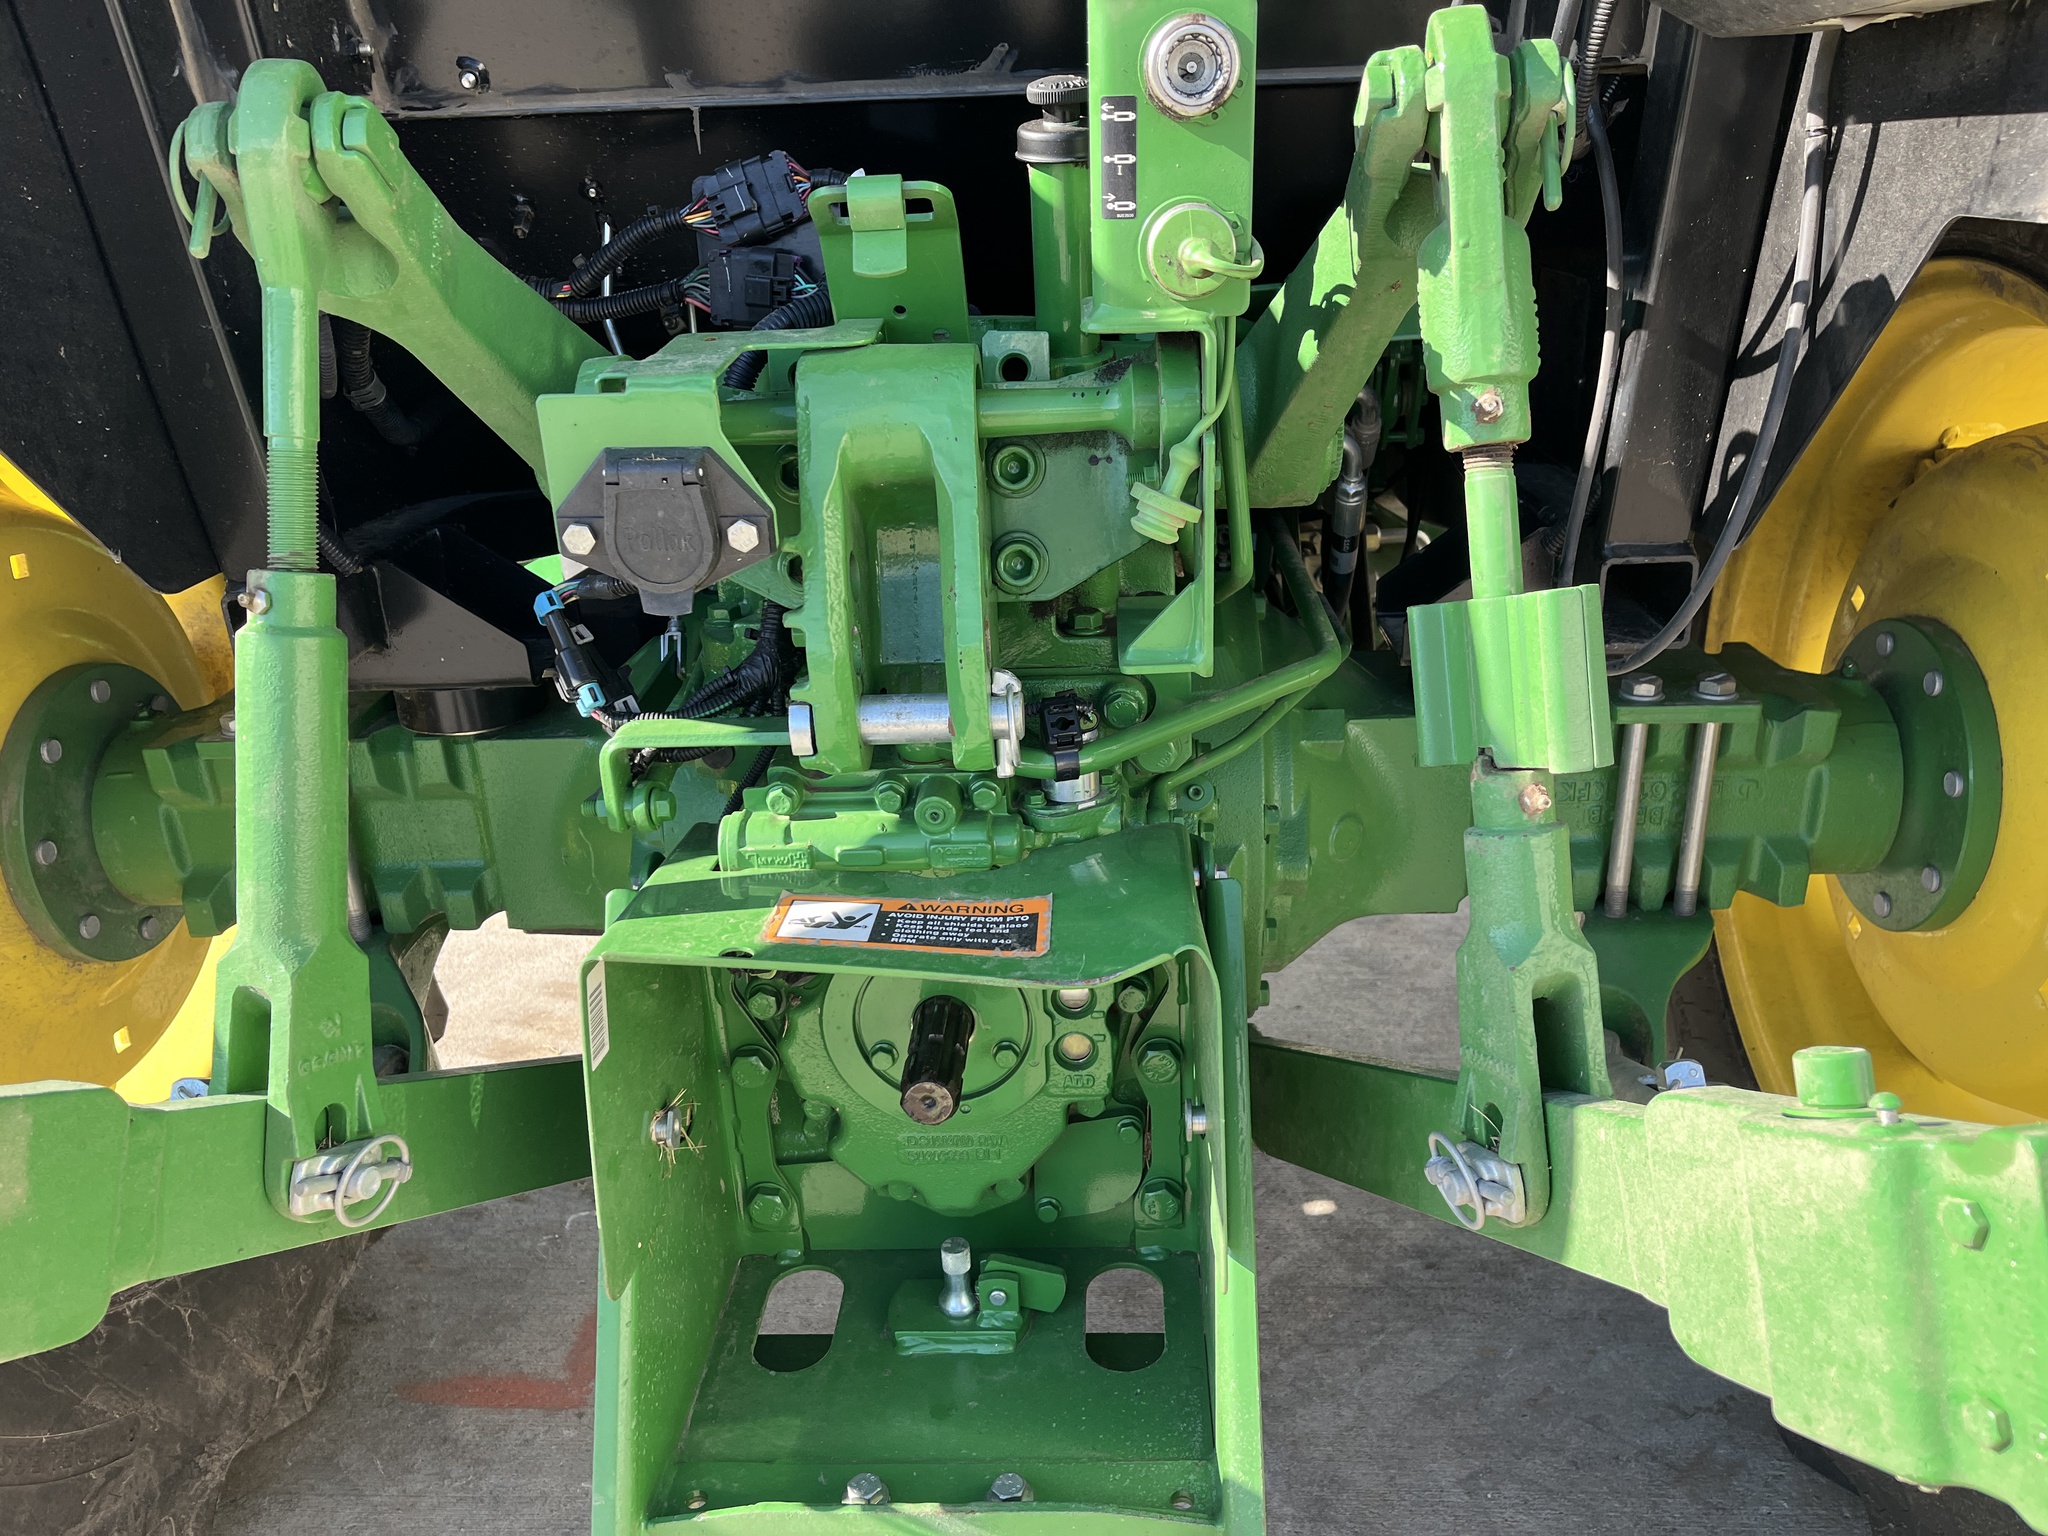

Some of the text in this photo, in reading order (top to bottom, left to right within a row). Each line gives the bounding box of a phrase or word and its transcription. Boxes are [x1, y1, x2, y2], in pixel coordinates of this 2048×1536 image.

[623, 525, 696, 553] Pollak
[921, 903, 1025, 914] WARNING
[892, 932, 937, 940] Operate
[894, 928, 940, 936] clothing
